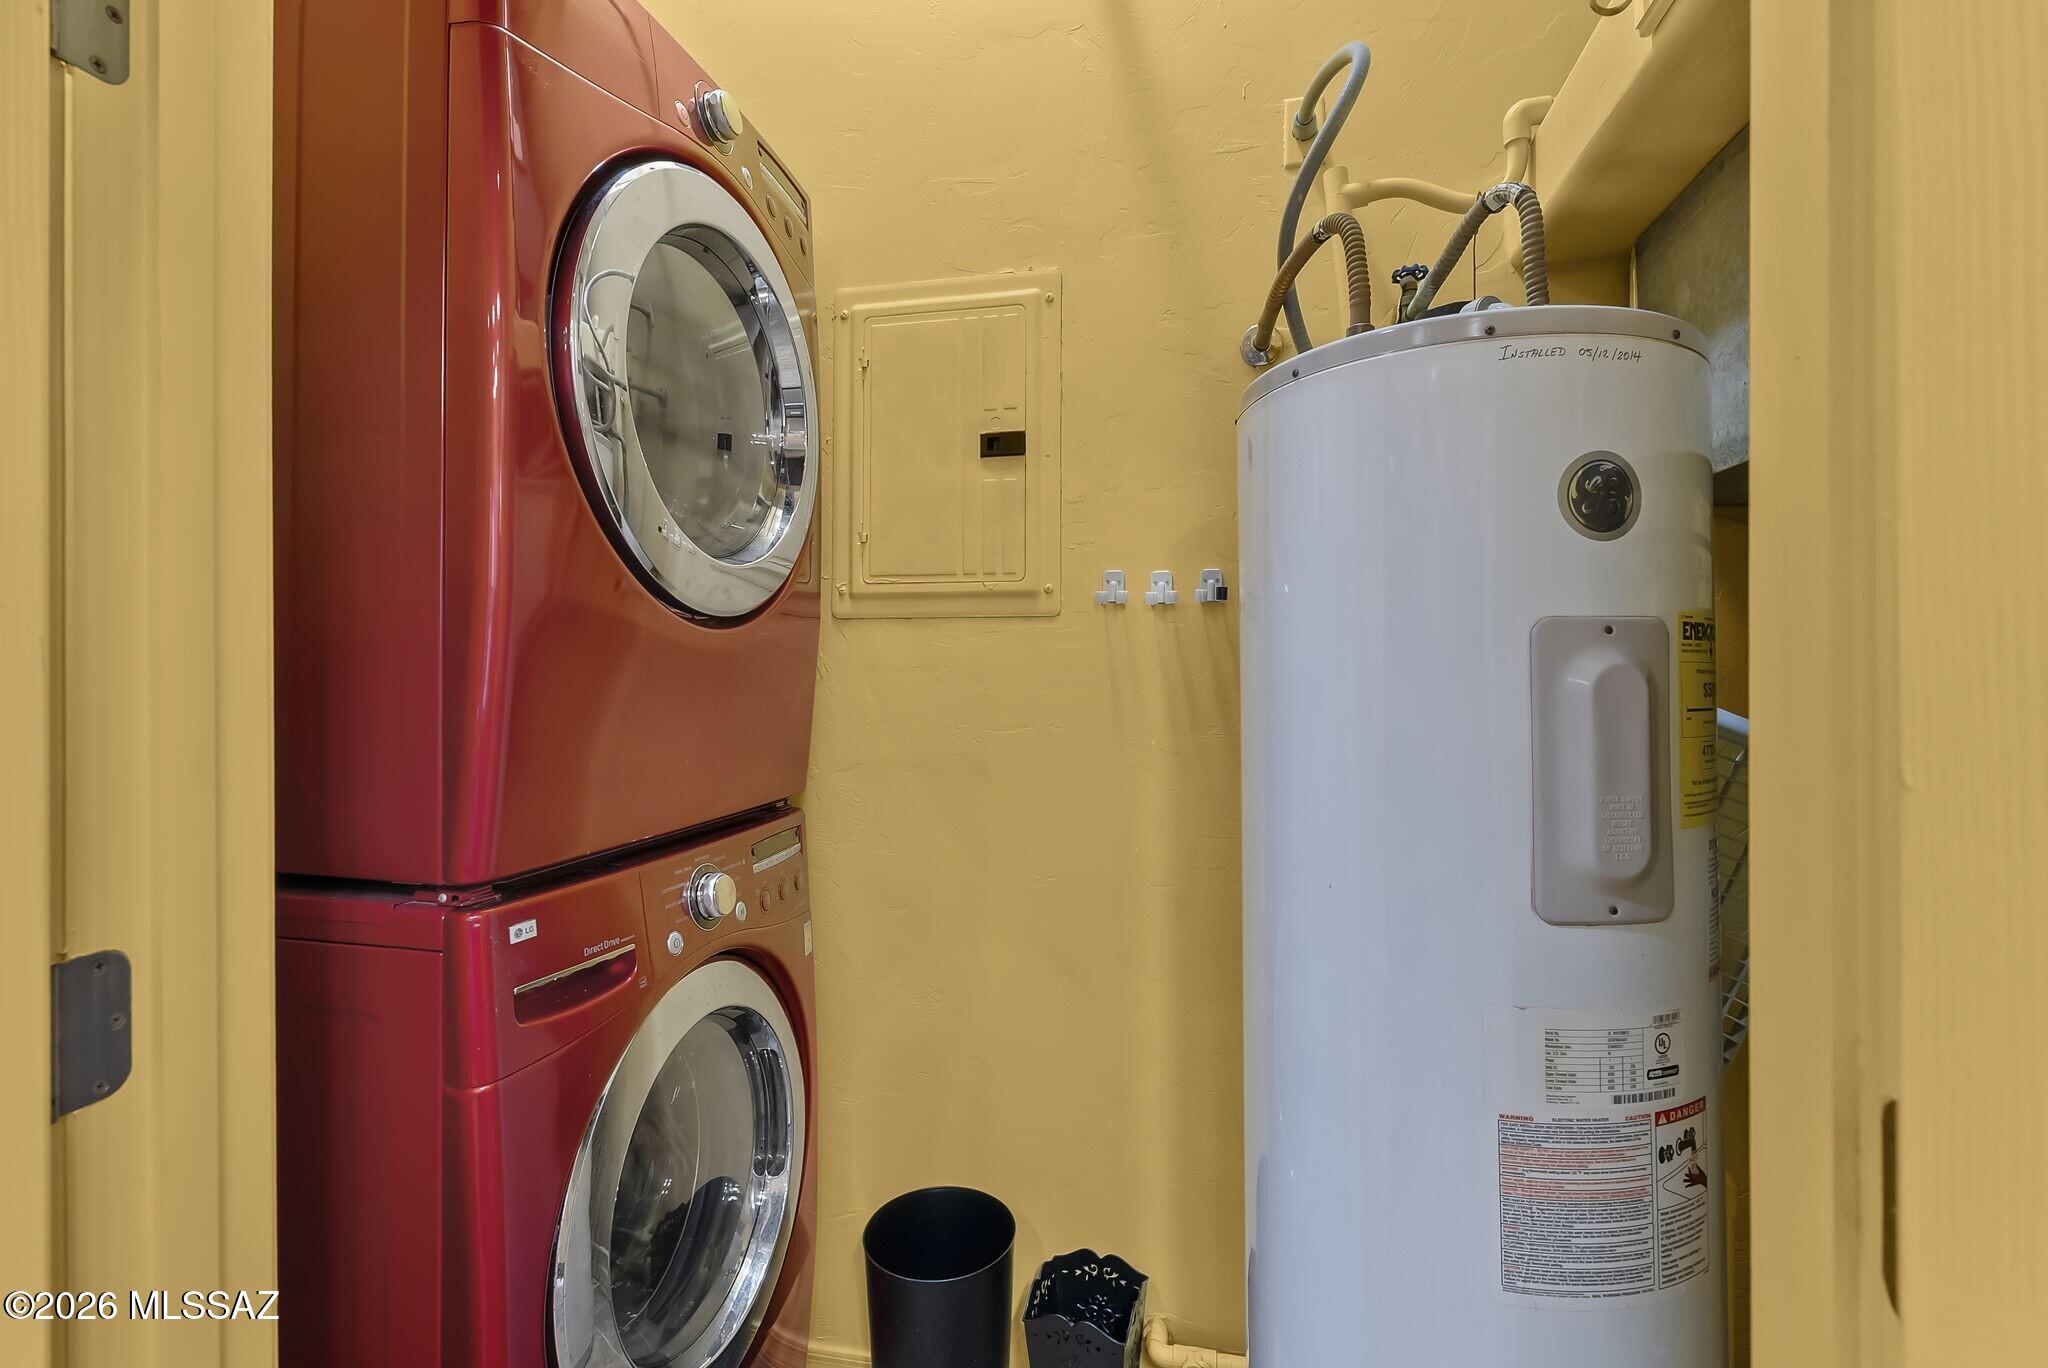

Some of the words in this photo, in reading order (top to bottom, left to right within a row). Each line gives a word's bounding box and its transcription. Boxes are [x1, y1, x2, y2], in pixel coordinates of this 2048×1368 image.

[1498, 344, 1566, 361] INSTALLED
[1578, 345, 1642, 363] 05/12/2014
[525, 925, 534, 934] LG
[584, 942, 604, 957] Direct
[604, 936, 621, 949] Drive
[1498, 1113, 1534, 1121] WARNING
[1625, 1113, 1651, 1121] CAUTION
[1669, 1100, 1704, 1121] DANGER
